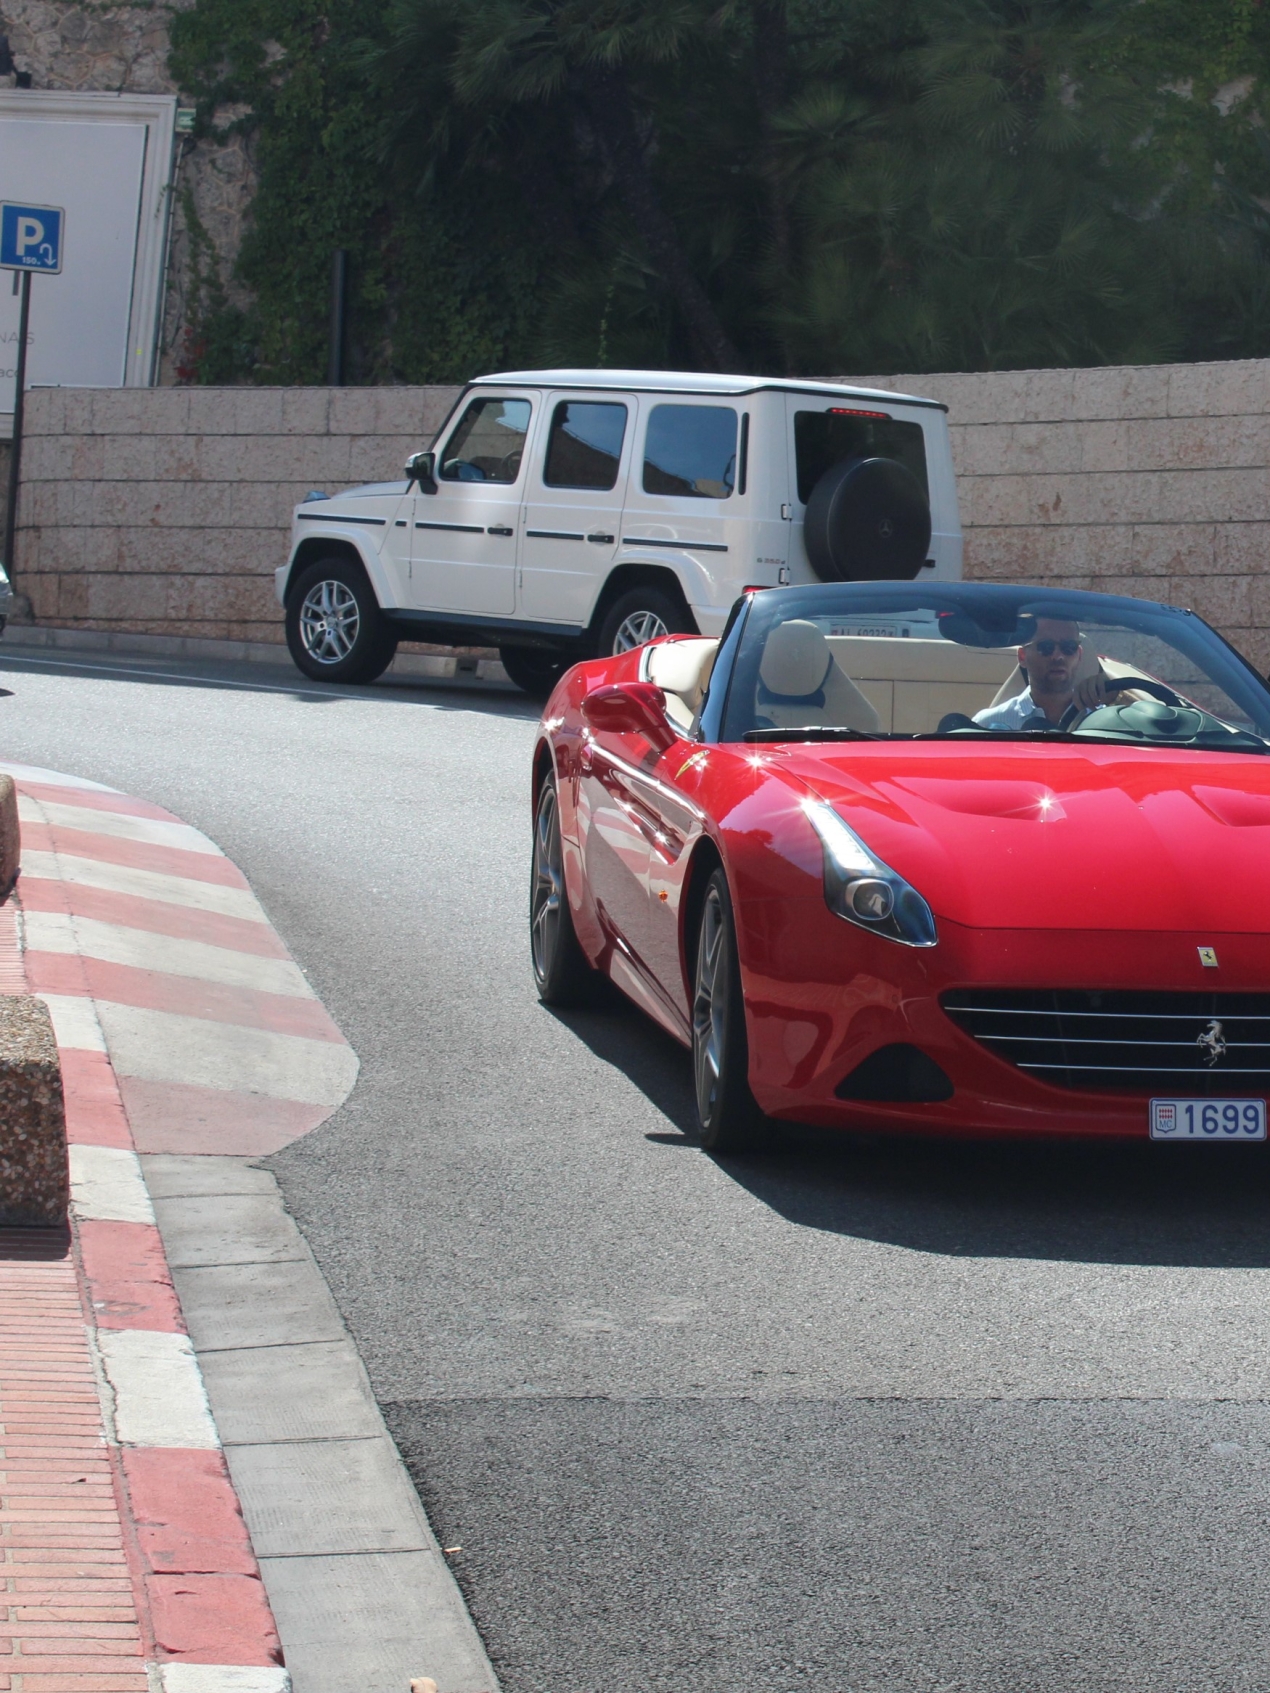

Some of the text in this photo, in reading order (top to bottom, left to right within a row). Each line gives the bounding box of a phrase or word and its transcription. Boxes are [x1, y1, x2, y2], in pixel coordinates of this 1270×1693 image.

[16, 216, 44, 256] P
[1159, 1120, 1173, 1129] MC
[1185, 1104, 1260, 1135] 1699
